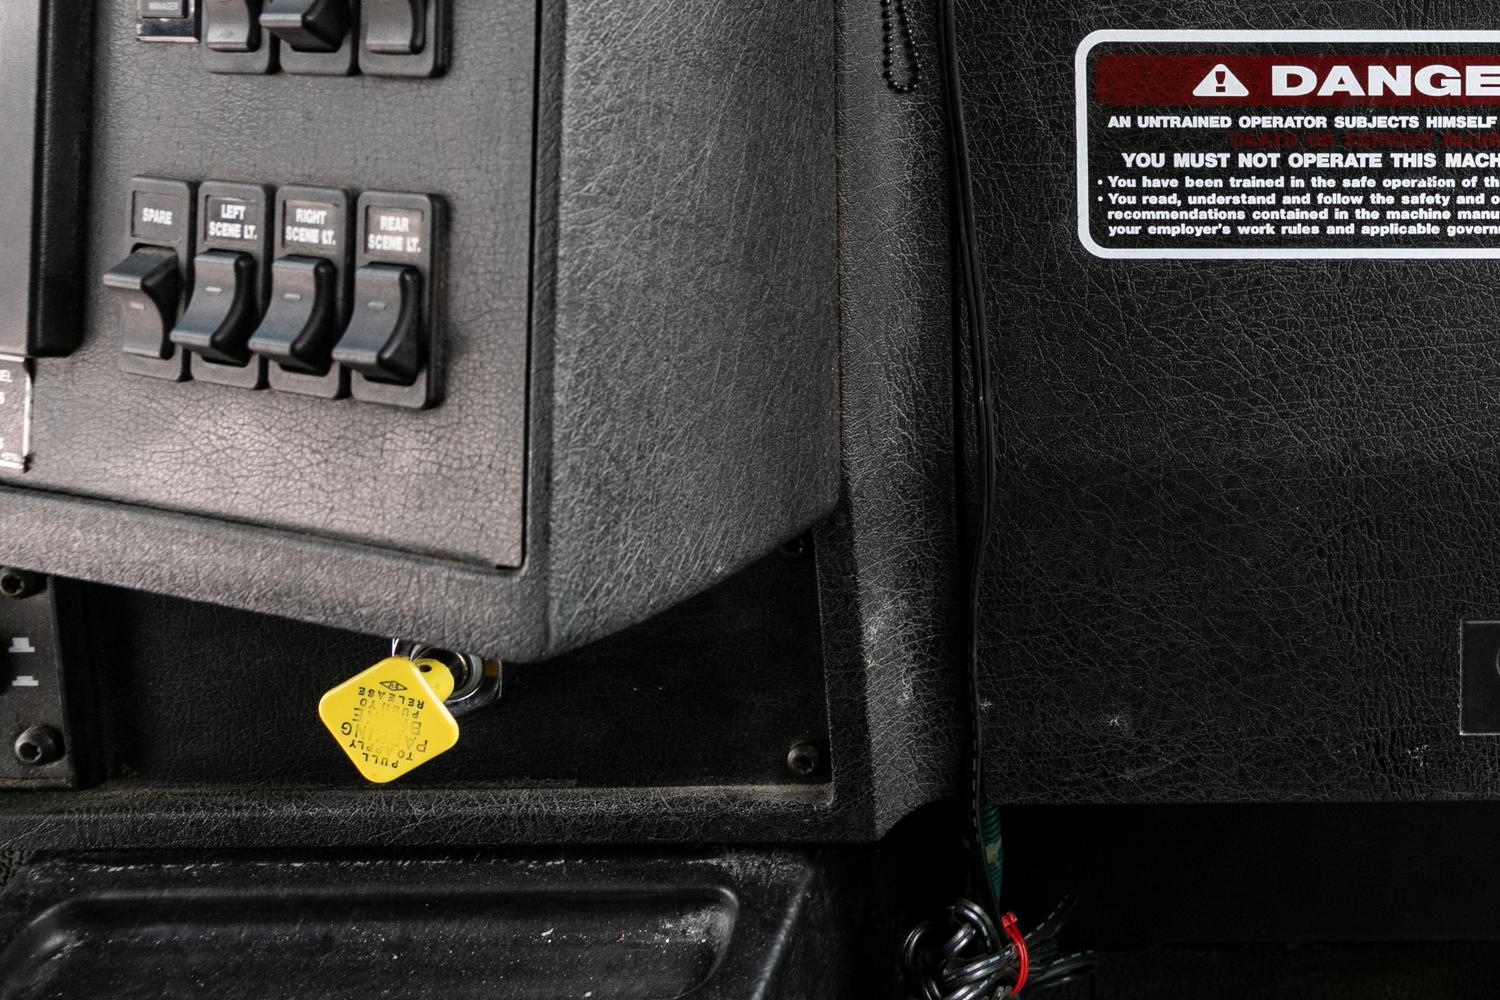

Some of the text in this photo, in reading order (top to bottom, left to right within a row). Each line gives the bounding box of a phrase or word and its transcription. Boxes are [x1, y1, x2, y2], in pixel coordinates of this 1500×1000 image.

[1108, 116, 1131, 127] AN
[1138, 116, 1231, 128] UNTRAINED
[1239, 116, 1327, 128] OPERATOR
[1335, 116, 1419, 128] SUBJECTS
[1427, 116, 1497, 128] HIMSELF
[1122, 153, 1165, 167] YOU
[1174, 153, 1230, 167] MUST
[1239, 153, 1280, 167] NOT
[1288, 153, 1382, 168] OPERATE
[1391, 153, 1436, 168] THIS
[1108, 176, 1136, 187] You
[1143, 176, 1178, 187] have
[1185, 176, 1223, 187] been
[1229, 176, 1284, 187] trained
[1291, 176, 1304, 187] in
[1311, 176, 1335, 187] the
[1343, 176, 1376, 187] safe
[1383, 176, 1455, 189] operation
[1462, 176, 1477, 187] of
[1108, 193, 1136, 204] You
[1142, 194, 1181, 206] read,
[1188, 193, 1275, 204] understand
[1283, 193, 1310, 204] and
[1317, 193, 1363, 204] follow
[1370, 193, 1394, 204] the
[1402, 193, 1450, 206] safety
[1457, 193, 1484, 204] and
[143, 207, 172, 225] SPARE
[221, 204, 246, 220] LEFT
[296, 208, 327, 225] RIGHT
[1108, 209, 1245, 219] recommendations
[1252, 208, 1328, 219] contained
[1335, 208, 1348, 219] in
[1355, 208, 1379, 219] the
[1387, 208, 1451, 219] machine
[209, 221, 257, 240] SCENE LT.
[380, 215, 409, 232] REAR
[1109, 226, 1141, 236] your
[1148, 224, 1230, 236] employer's
[1237, 224, 1275, 234] work
[1282, 223, 1319, 234] rules
[1327, 223, 1354, 234] and
[1361, 223, 1440, 236] applicable
[285, 225, 336, 246] SCENE LT.
[368, 234, 421, 253] SCENE LT.
[358, 686, 425, 709] RELEASE
[359, 698, 377, 710] TO
[341, 721, 428, 753] PAING
[362, 752, 399, 768] PULL
[398, 751, 413, 761] TO
